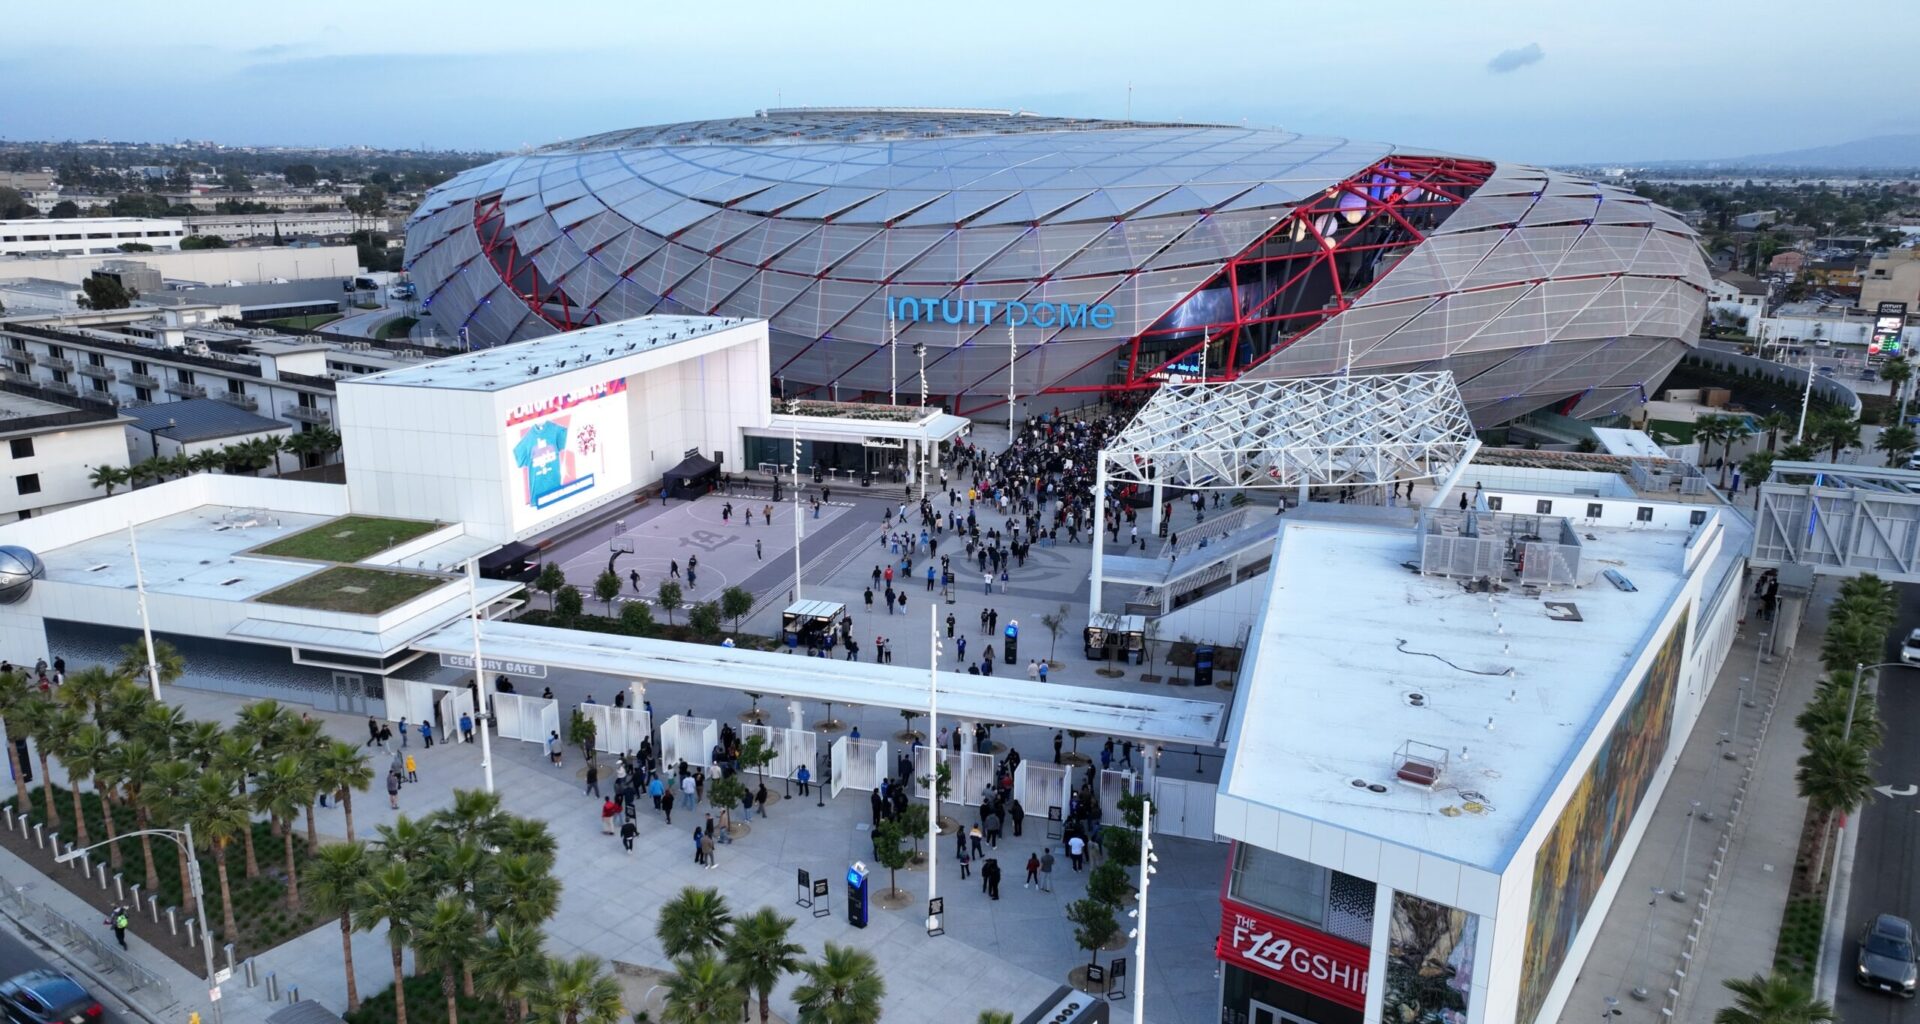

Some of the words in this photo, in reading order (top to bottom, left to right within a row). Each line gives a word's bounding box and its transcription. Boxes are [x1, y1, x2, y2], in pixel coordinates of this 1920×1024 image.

[888, 296, 998, 325] INTUIT
[506, 662, 537, 675] GATE
[1235, 914, 1257, 931] THE
